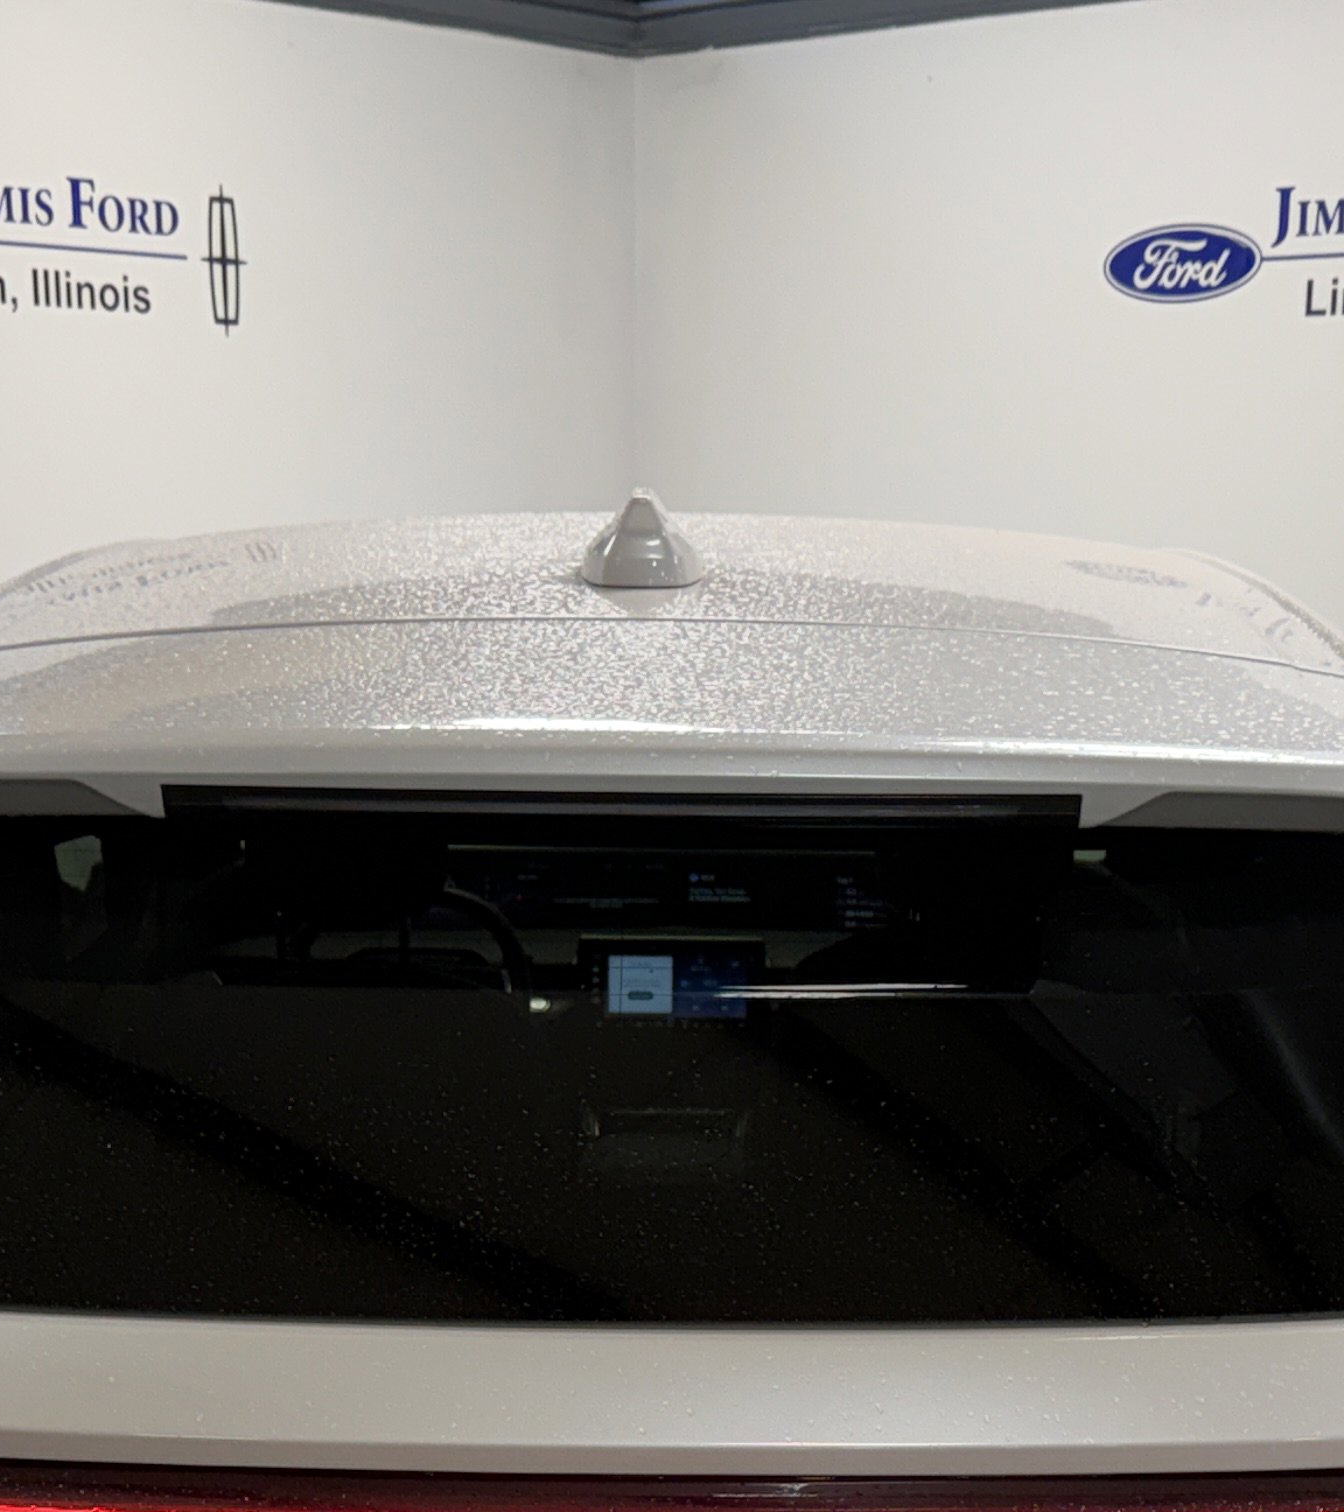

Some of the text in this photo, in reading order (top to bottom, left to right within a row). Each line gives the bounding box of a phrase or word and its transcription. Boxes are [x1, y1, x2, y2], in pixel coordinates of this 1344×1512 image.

[66, 177, 179, 236] FORD
[1133, 239, 1231, 290] Ford
[31, 268, 152, 315] Illinois
